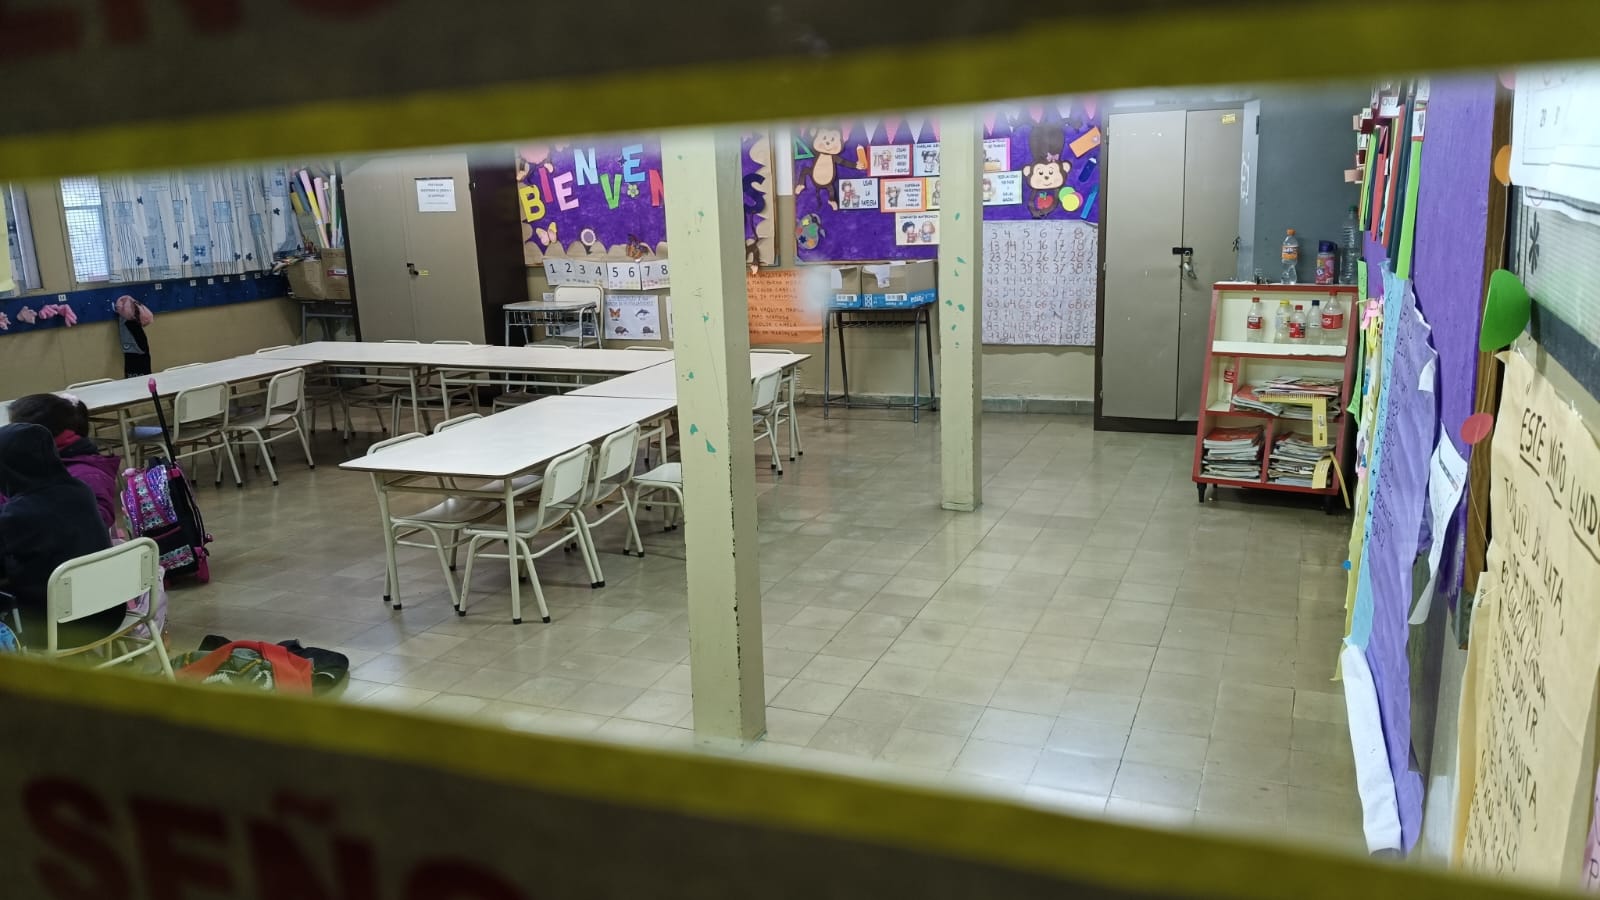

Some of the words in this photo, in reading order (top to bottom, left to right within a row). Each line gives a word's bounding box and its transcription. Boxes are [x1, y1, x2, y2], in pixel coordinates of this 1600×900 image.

[550, 263, 557, 274] 1
[565, 262, 572, 273] 2
[579, 264, 586, 275] 3
[594, 265, 602, 276] 4
[612, 267, 619, 278] 5
[628, 267, 635, 278] 6
[644, 266, 650, 277] 7
[661, 264, 668, 275] 8
[1520, 408, 1547, 463] ESTE
